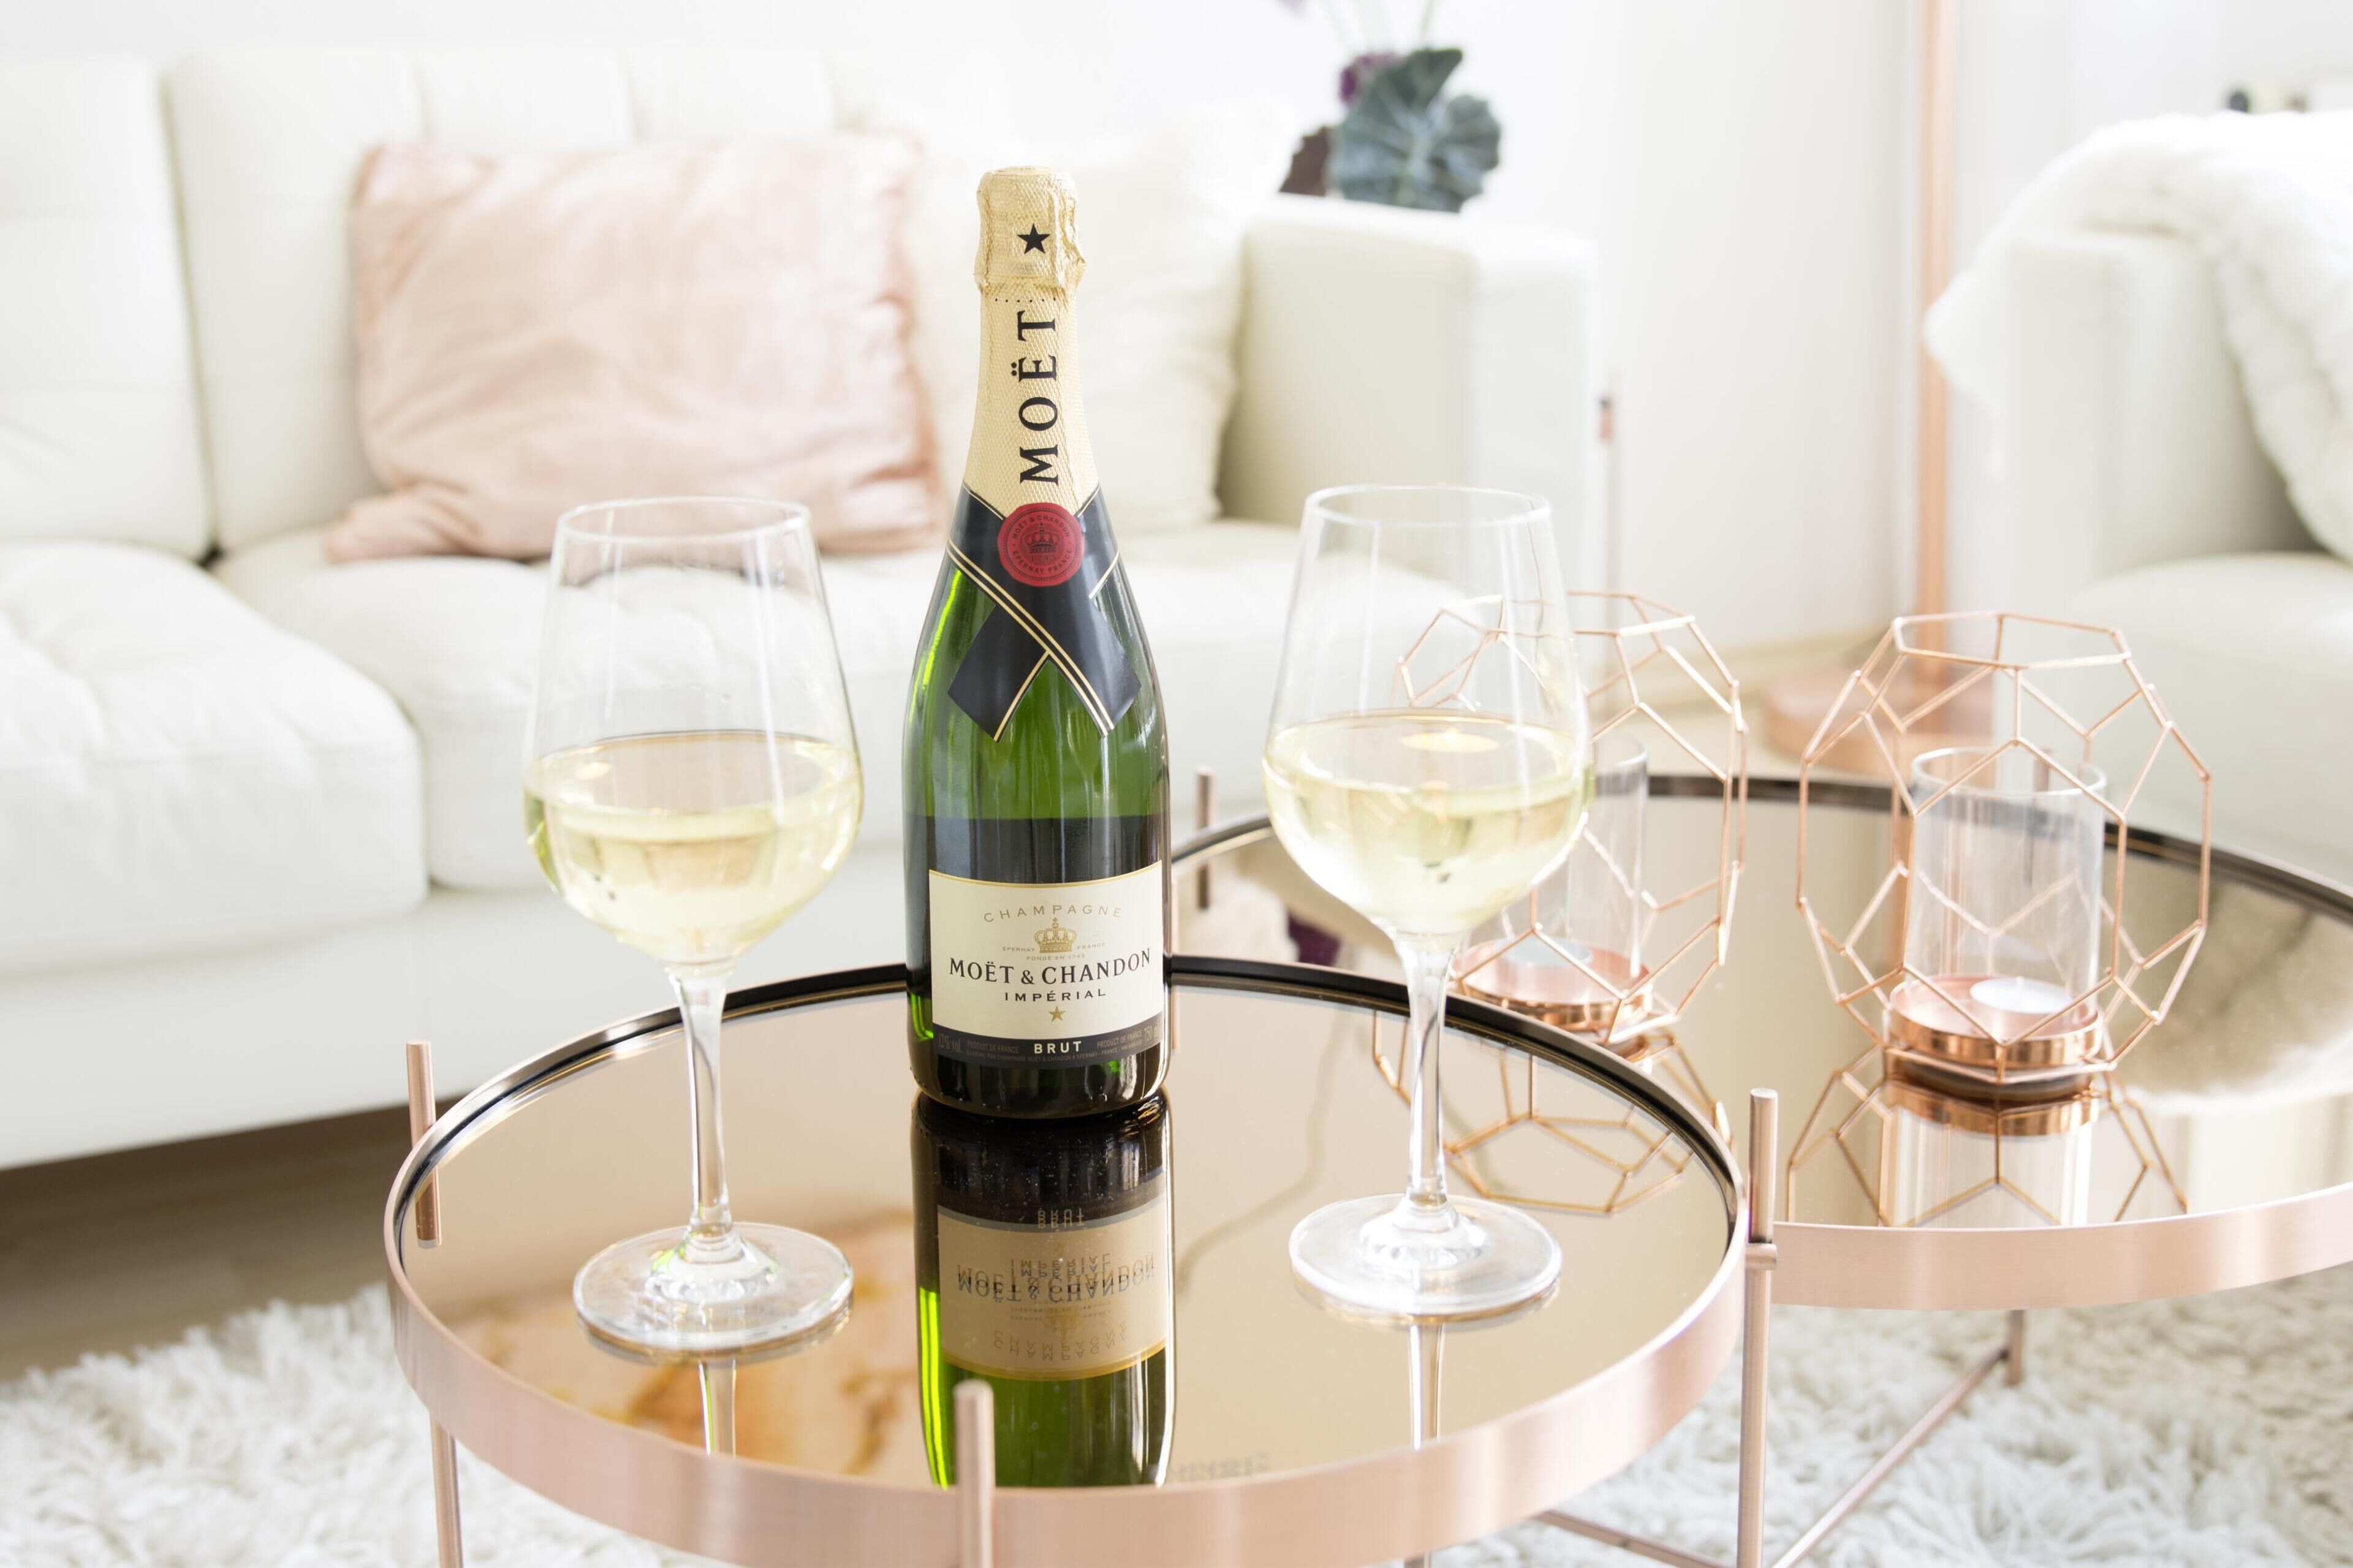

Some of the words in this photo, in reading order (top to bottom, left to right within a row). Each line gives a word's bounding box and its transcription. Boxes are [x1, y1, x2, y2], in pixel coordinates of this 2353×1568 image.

[1011, 310, 1058, 486] MOËT
[1037, 515, 1070, 537] CHANDON
[1047, 549, 1072, 574] FRANCE
[984, 904, 1123, 922] CHAMPAGNE
[1077, 942, 1106, 950] FRANCE
[949, 957, 1014, 984] MOËT
[1021, 969, 1036, 985] &
[1042, 948, 1151, 985] CHANDON
[1005, 988, 1107, 1002] IMPÉRIAL
[1034, 1040, 1082, 1054] BRUT
[1097, 1038, 1119, 1049] PRODUCT
[1127, 1029, 1143, 1041] FRANCE
[997, 1044, 1020, 1054] FRANCE
